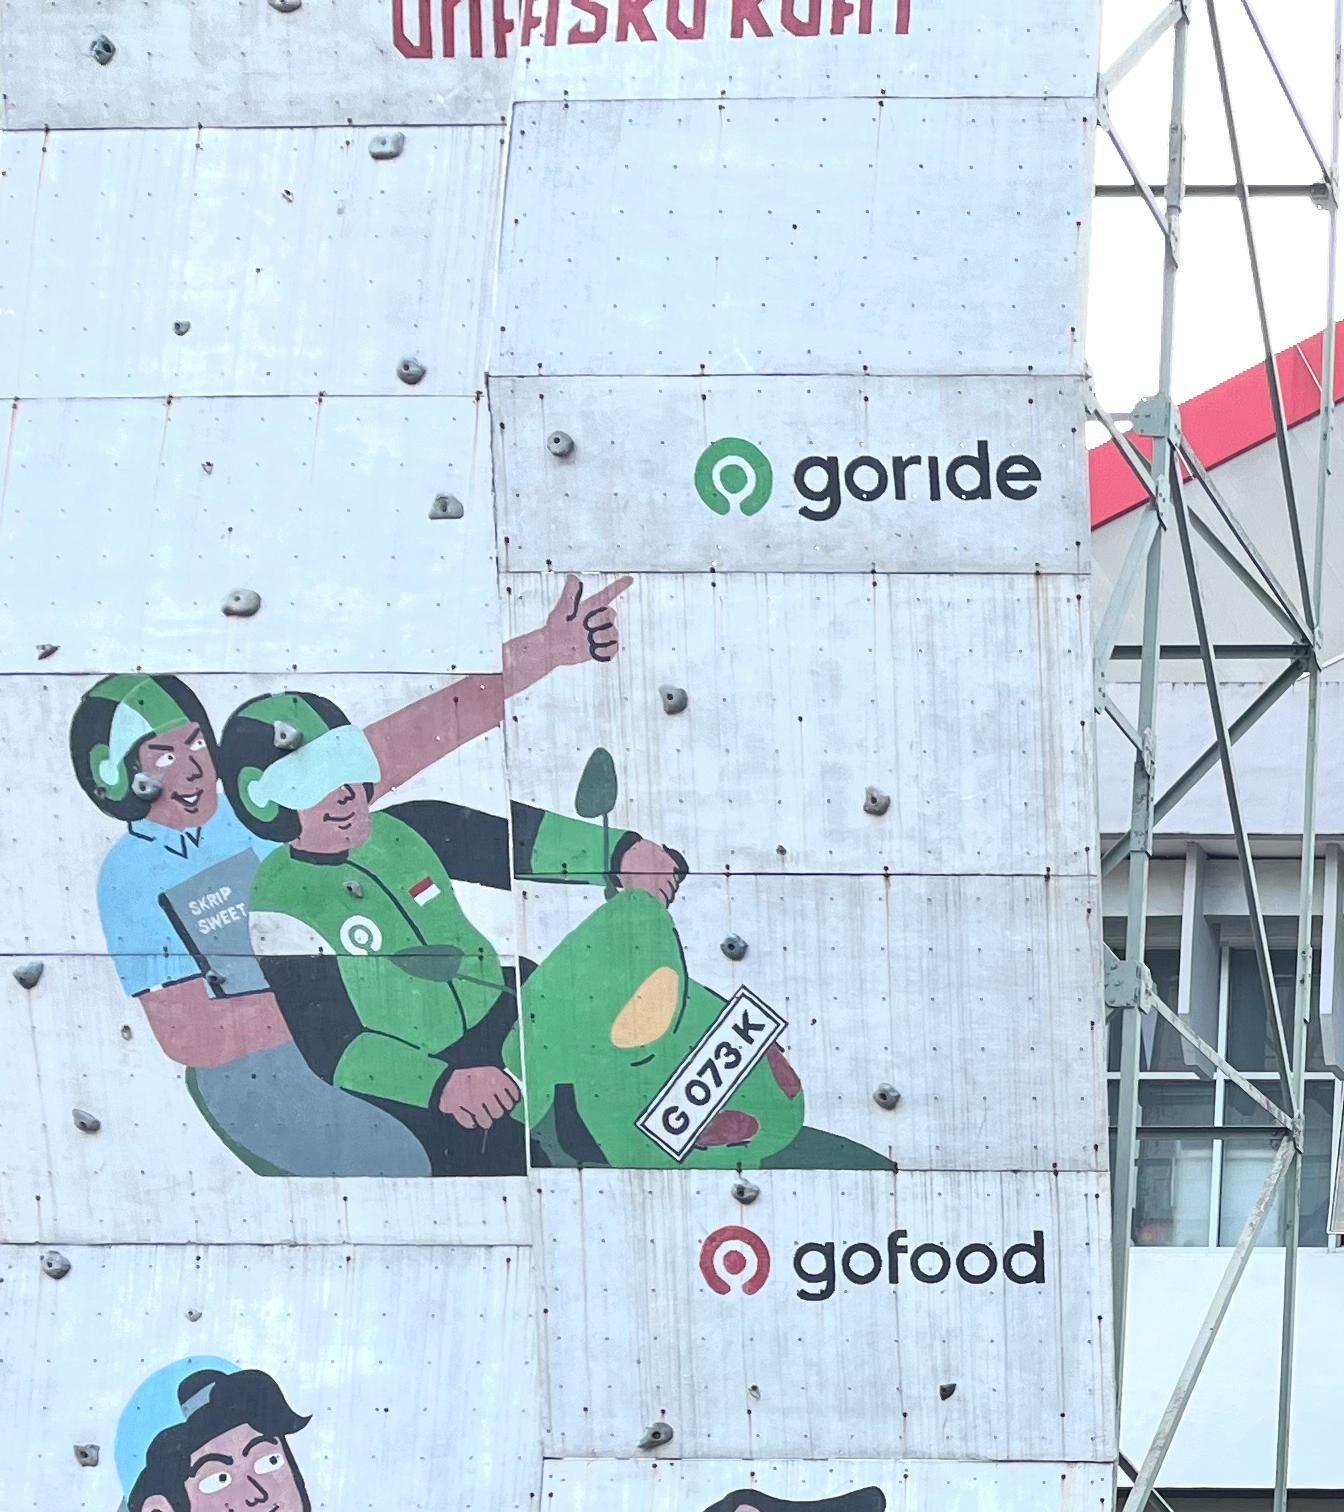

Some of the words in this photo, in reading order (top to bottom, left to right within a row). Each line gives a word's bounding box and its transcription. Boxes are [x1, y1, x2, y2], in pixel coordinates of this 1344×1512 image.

[794, 439, 1042, 522] goride
[188, 886, 232, 915] SKRIP
[198, 903, 247, 935] SWEET
[662, 1105, 690, 1135] G
[685, 1041, 742, 1106] 073
[731, 1009, 766, 1045] K
[793, 1230, 1045, 1302] gofood
